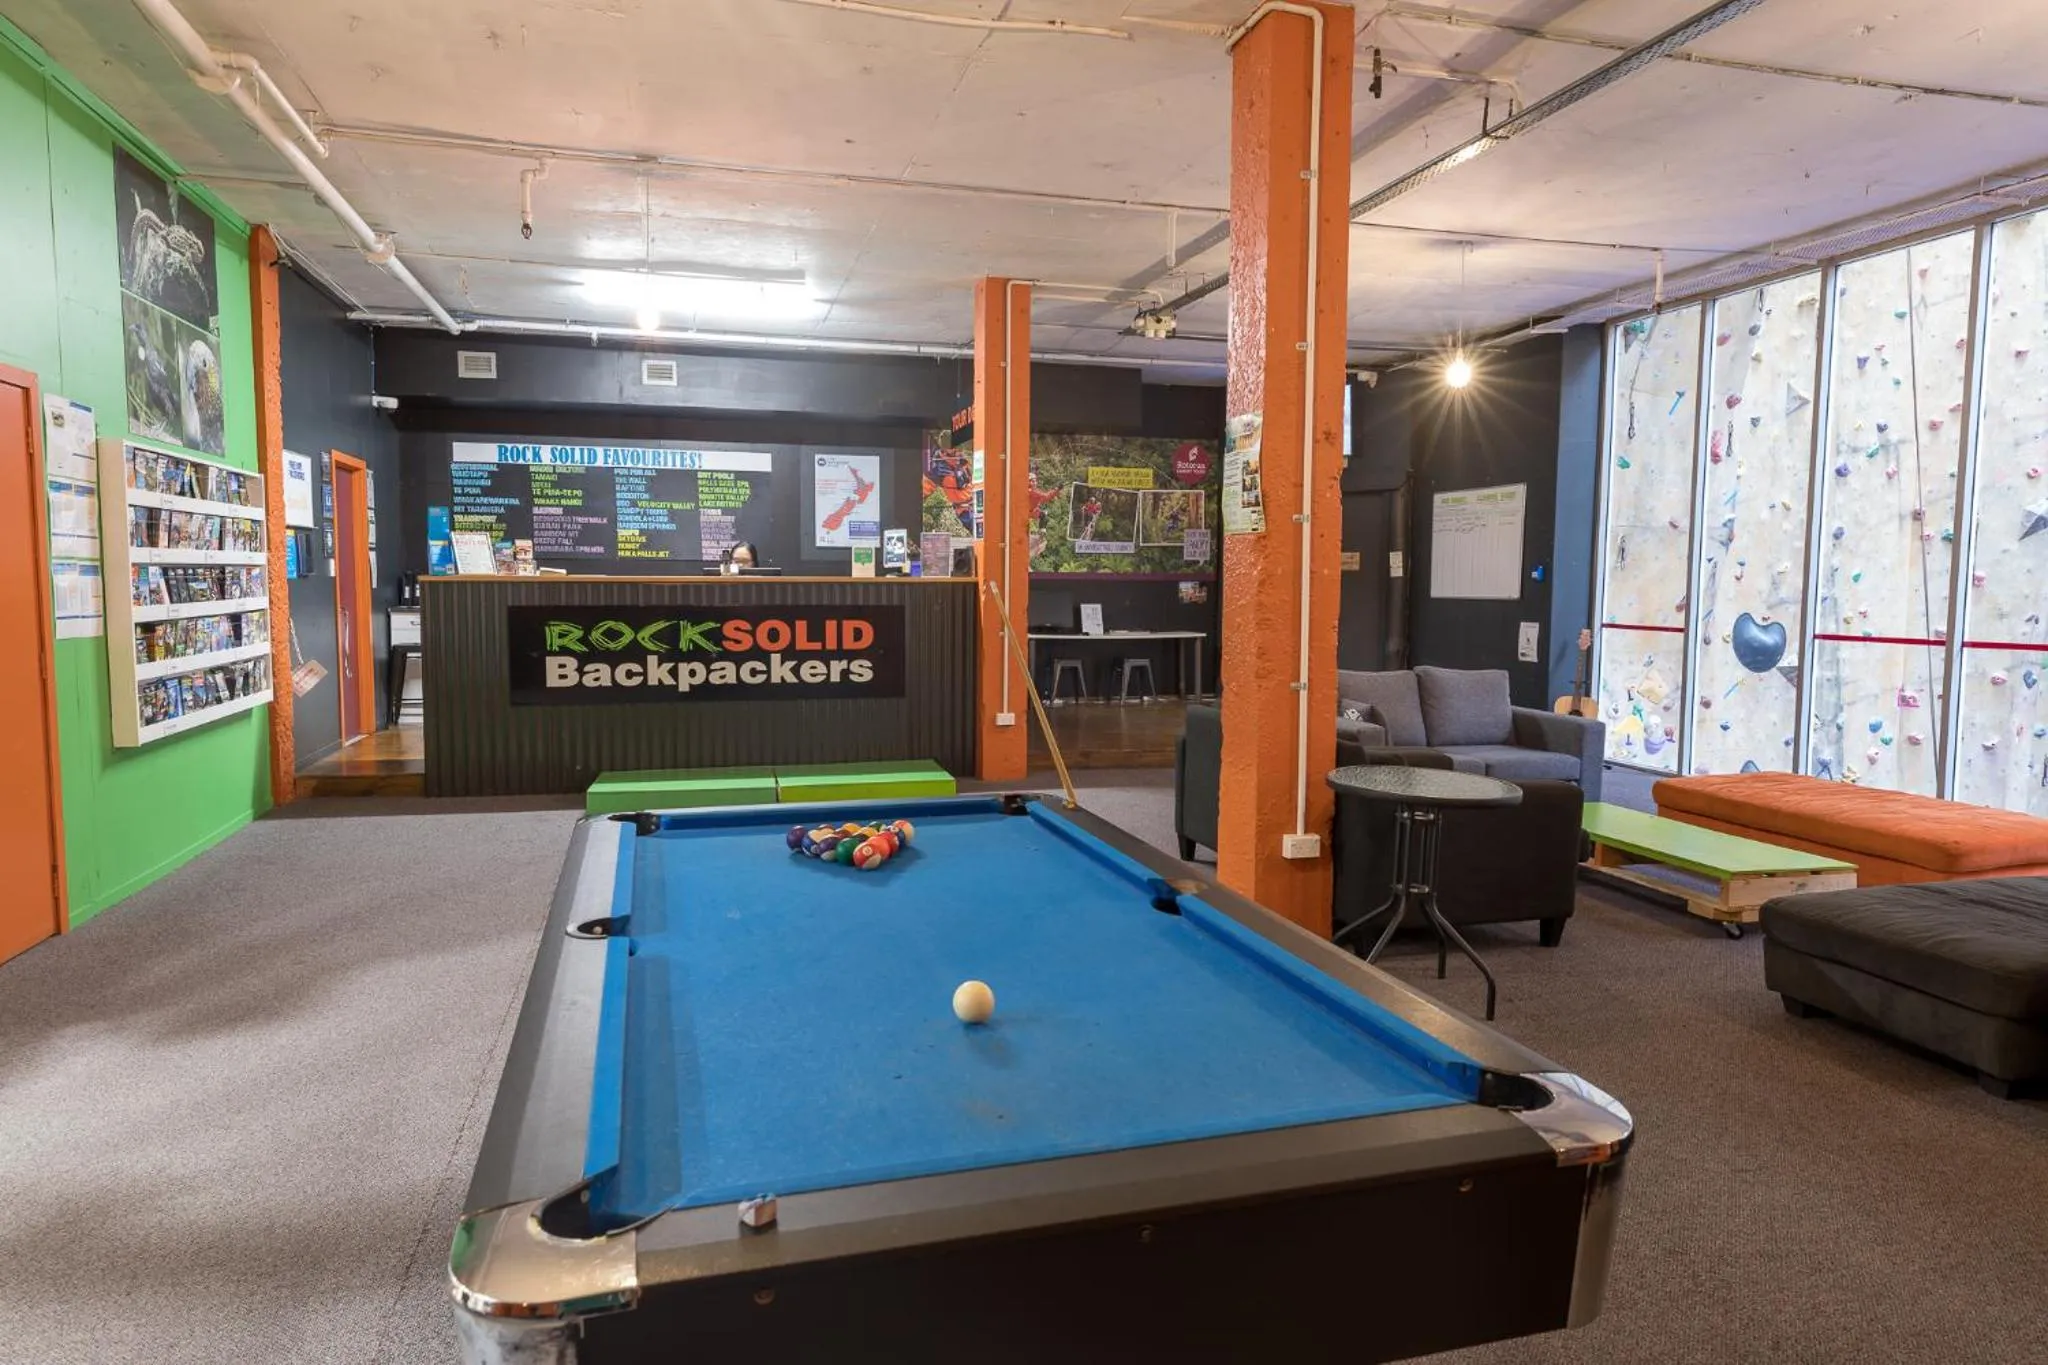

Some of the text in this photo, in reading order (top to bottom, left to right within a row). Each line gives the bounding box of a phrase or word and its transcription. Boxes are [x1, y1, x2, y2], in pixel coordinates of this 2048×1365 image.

[497, 445, 703, 469] ROCK SOLID FAVOURITES!
[545, 653, 875, 692] Backpackers
